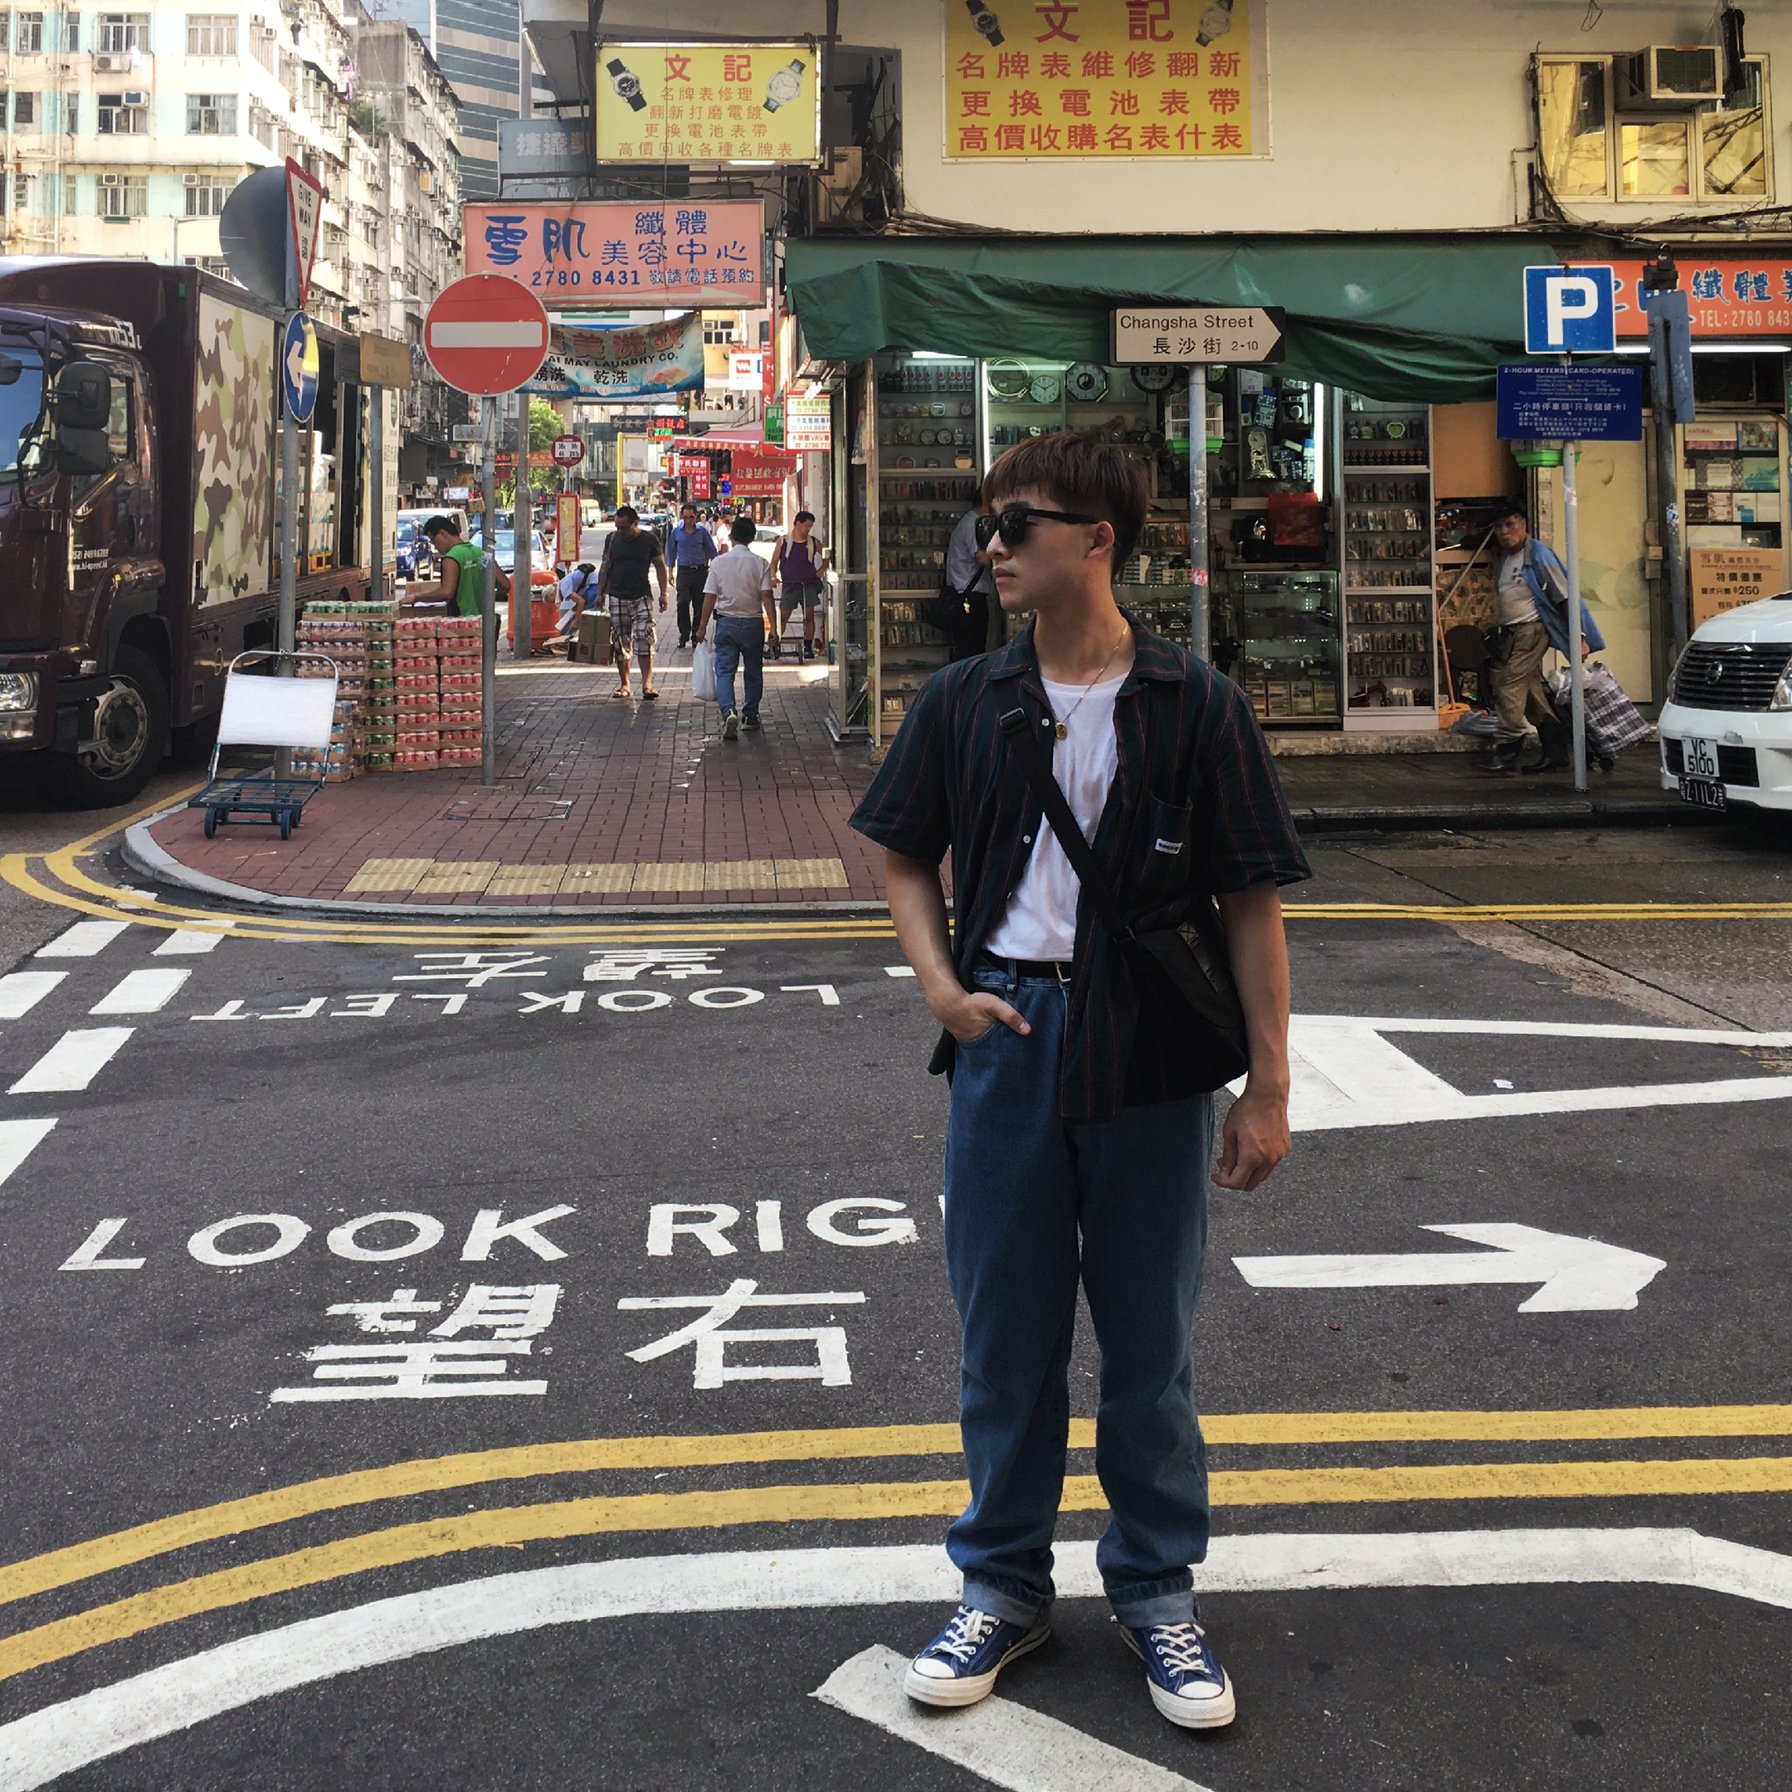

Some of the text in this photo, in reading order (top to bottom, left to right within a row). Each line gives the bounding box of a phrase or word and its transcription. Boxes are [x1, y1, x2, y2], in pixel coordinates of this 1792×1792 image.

[1034, 0, 1175, 44] 文記
[663, 53, 752, 82] 文記
[956, 50, 1242, 80] 名牌表維修翻新
[660, 86, 752, 102] 名牌表修理
[960, 87, 1242, 118] 更換電池表帶
[649, 104, 763, 121] 翻新打磨電鍍
[644, 123, 768, 139] 更換電池表帶
[958, 122, 1243, 152] 高價收購名表什表
[618, 141, 793, 158] 高價回收各種名牌表
[298, 183, 312, 208] GIVE
[298, 206, 312, 228] WAY
[635, 209, 708, 237] 纖體
[485, 215, 591, 267] 雪肌
[600, 238, 748, 267] 美容中心
[532, 269, 641, 287] 2780 8431
[649, 268, 755, 285] 敬請電話預約
[1545, 276, 1599, 346] P
[1699, 309, 1792, 328] TEL: 2780 843
[1120, 315, 1254, 331] Changsha Street
[1152, 337, 1222, 355] 長沙街
[564, 358, 591, 367] MAY
[594, 354, 655, 368] LAUNDRY
[658, 352, 679, 362] CO.
[593, 369, 629, 386] 乾洗
[1687, 755, 1715, 775] 5100
[189, 984, 842, 1020] LOOK LEFT
[58, 1195, 947, 1272] LOOK RIG
[268, 1277, 867, 1403] 望右
